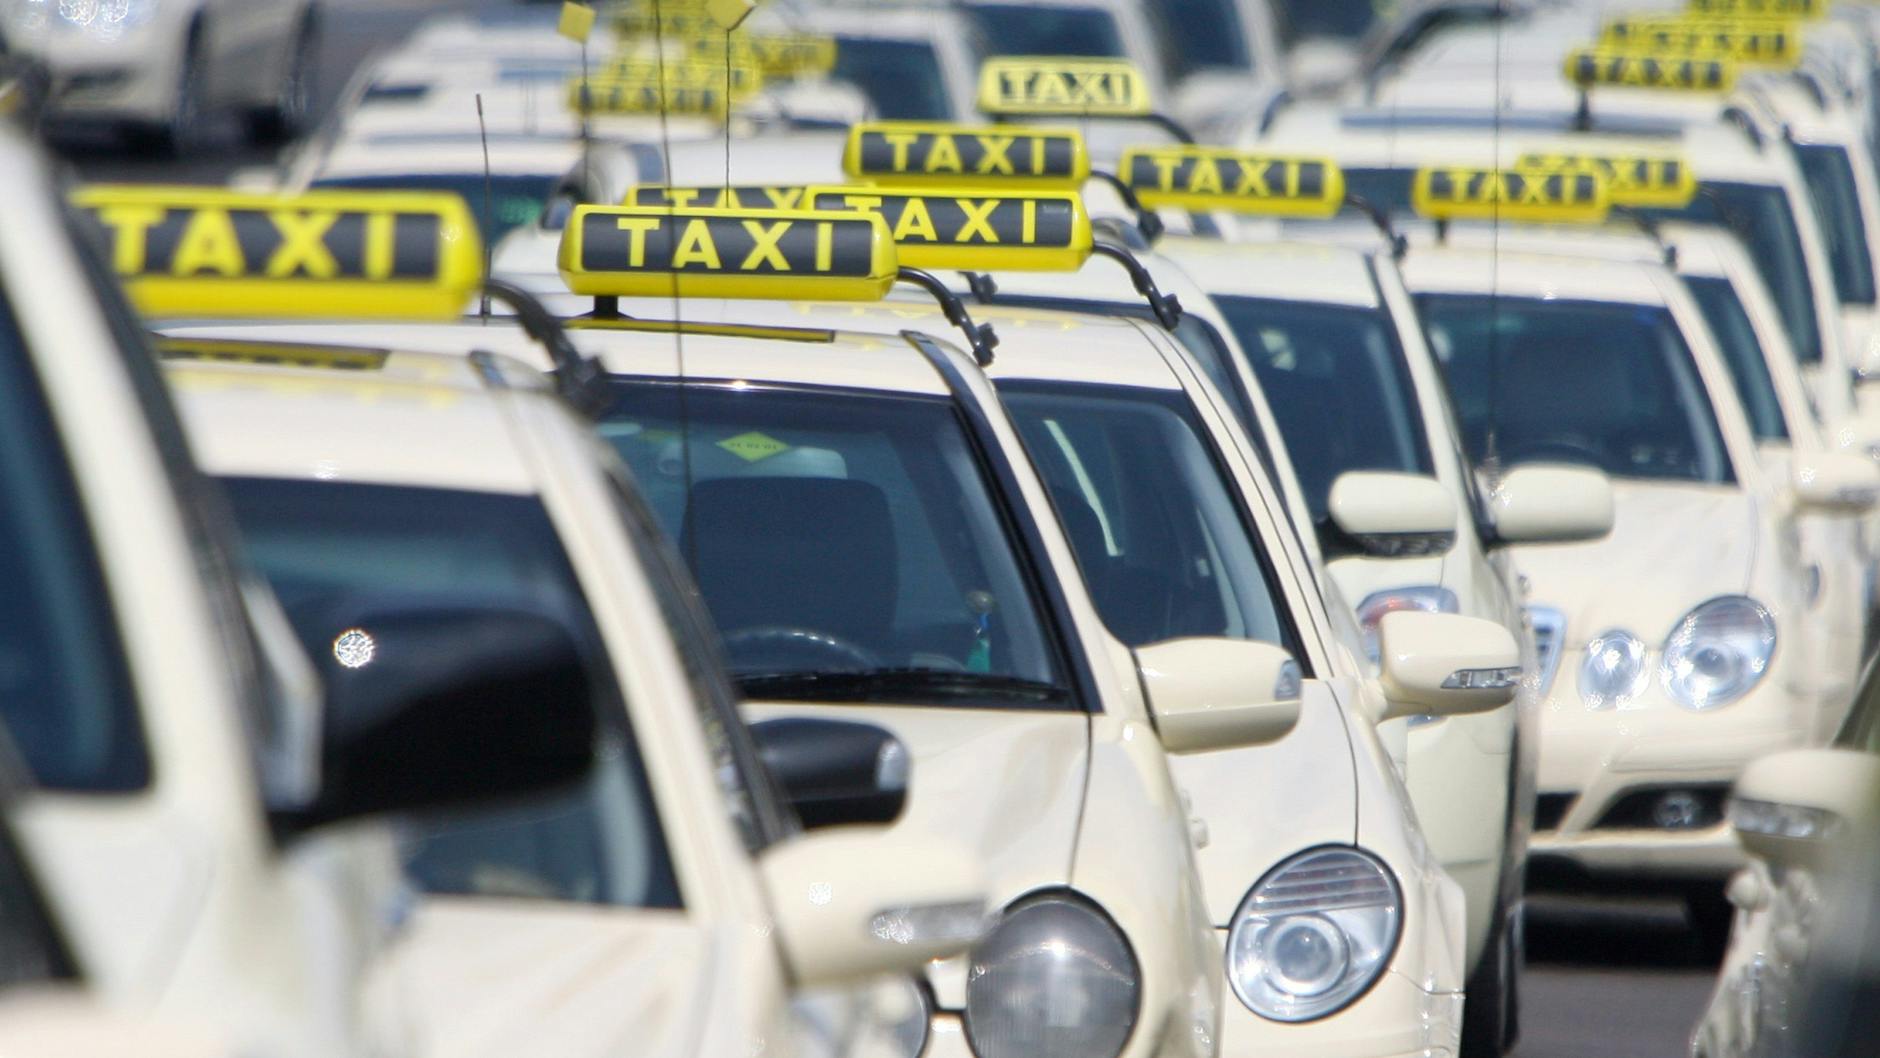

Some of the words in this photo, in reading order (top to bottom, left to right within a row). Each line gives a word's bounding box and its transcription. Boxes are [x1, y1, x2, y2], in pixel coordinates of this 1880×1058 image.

[1003, 69, 1125, 102] TAXI
[886, 134, 1047, 172] TAXI
[1154, 158, 1300, 196] TAXI
[1448, 173, 1579, 203] TAXI
[664, 188, 805, 209] TAX
[101, 206, 395, 277] TAXI
[617, 217, 834, 272] TAXI
